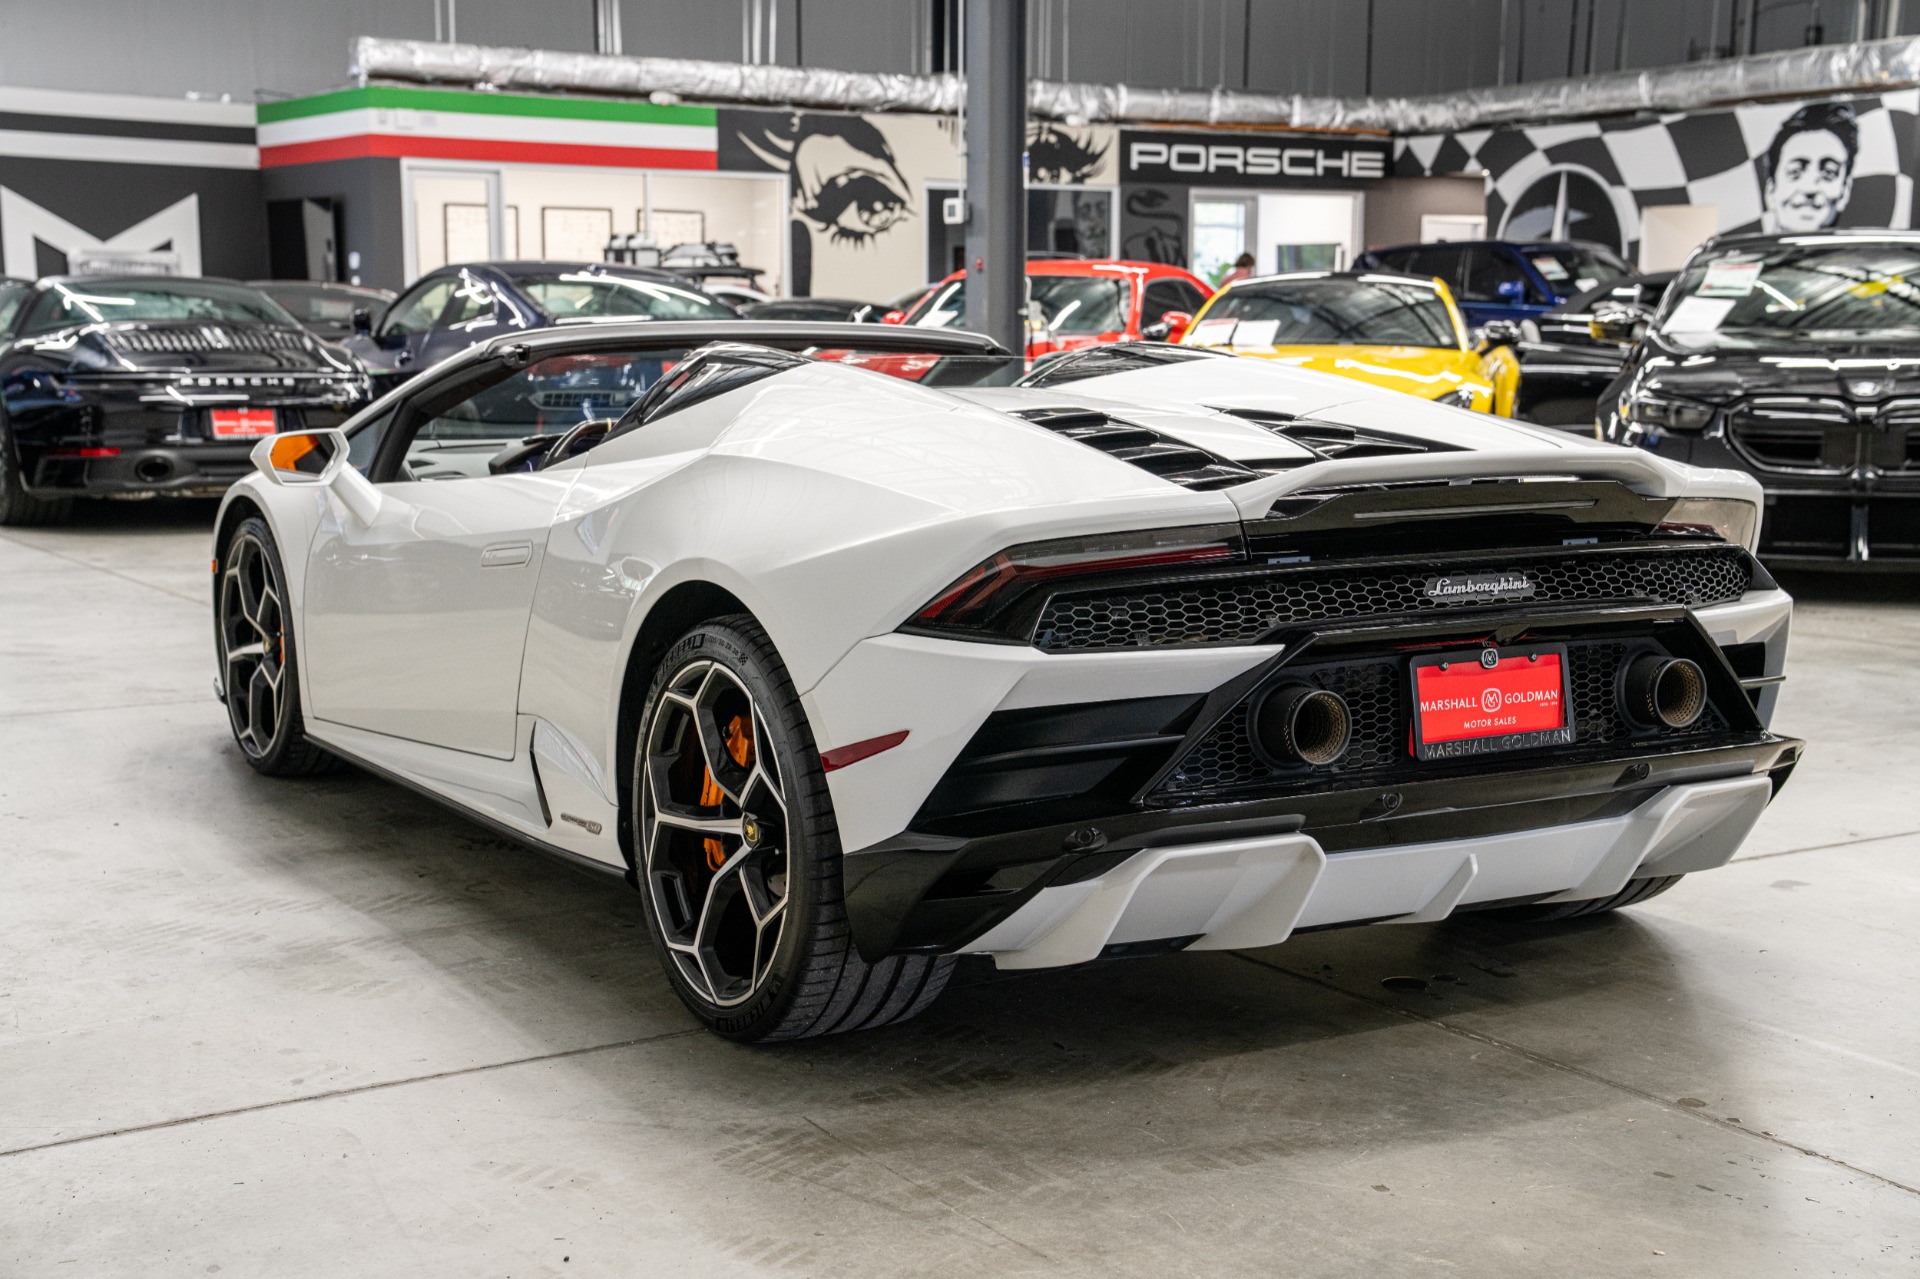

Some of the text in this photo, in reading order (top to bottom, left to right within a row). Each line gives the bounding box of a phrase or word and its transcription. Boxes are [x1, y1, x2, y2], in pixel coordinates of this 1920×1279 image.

[1130, 142, 1385, 178] PORSCHE
[1427, 576, 1530, 596] Lamborghini
[1420, 689, 1558, 712] MARSHALL GOLDMAN
[1463, 716, 1517, 729] MOTOR SALES
[1424, 729, 1571, 759] MARSHALL GOLDMAN
